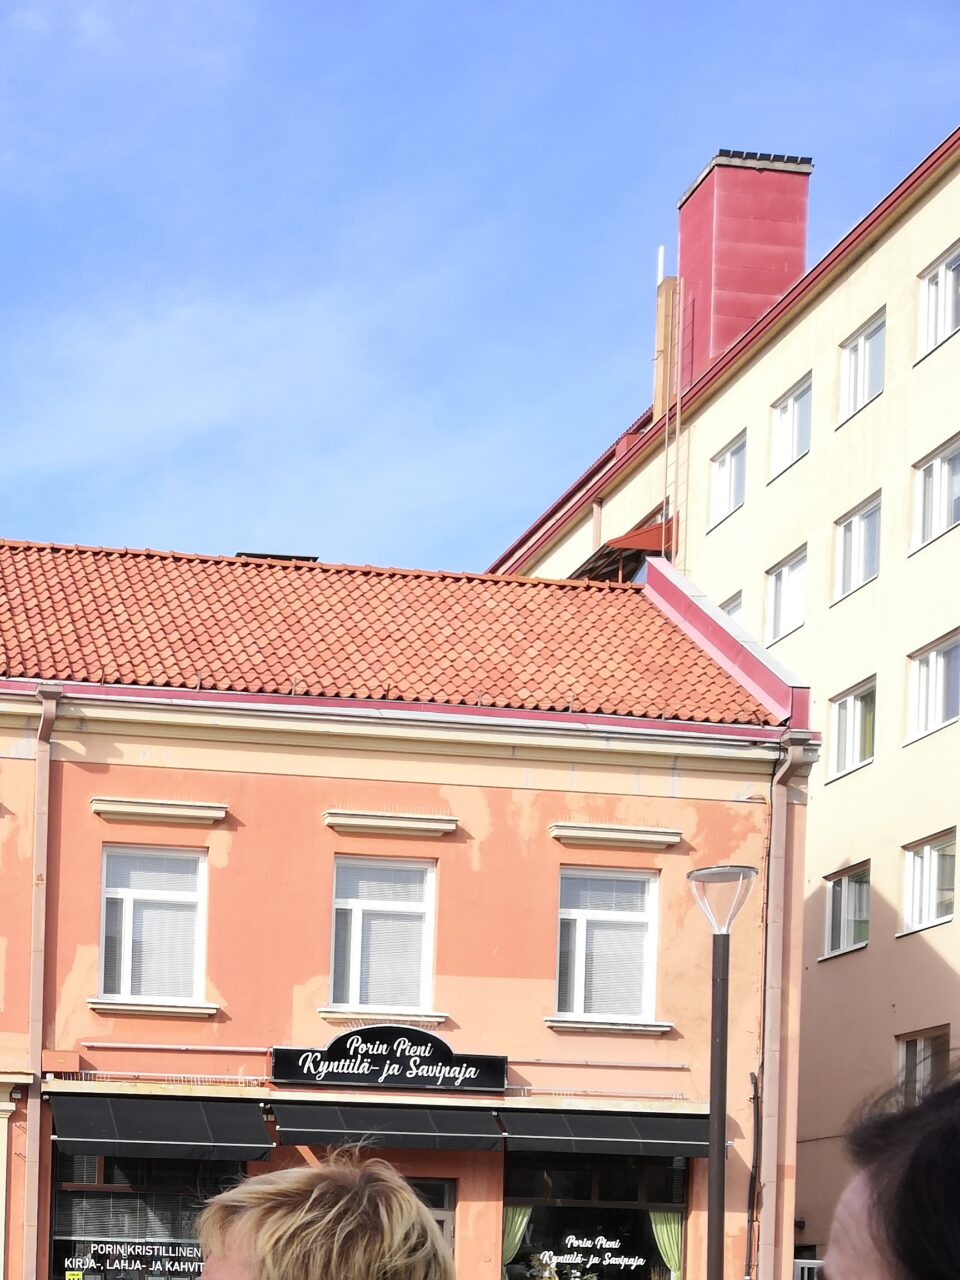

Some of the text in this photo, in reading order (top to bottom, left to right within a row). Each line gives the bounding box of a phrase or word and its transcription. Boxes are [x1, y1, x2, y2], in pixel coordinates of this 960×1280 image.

[346, 1035, 433, 1058] Porin Pieni
[298, 1052, 480, 1086] Kynttilä- ja Savipaja
[565, 1235, 621, 1249] Porin Pieni
[90, 1243, 202, 1258] PORIN KRISTILLINEN
[106, 1259, 146, 1270] LAHJA-
[149, 1261, 163, 1271] JA
[165, 1260, 206, 1273] KAHVIT
[586, 1253, 601, 1268] ja
[602, 1252, 646, 1270] Savipaja
